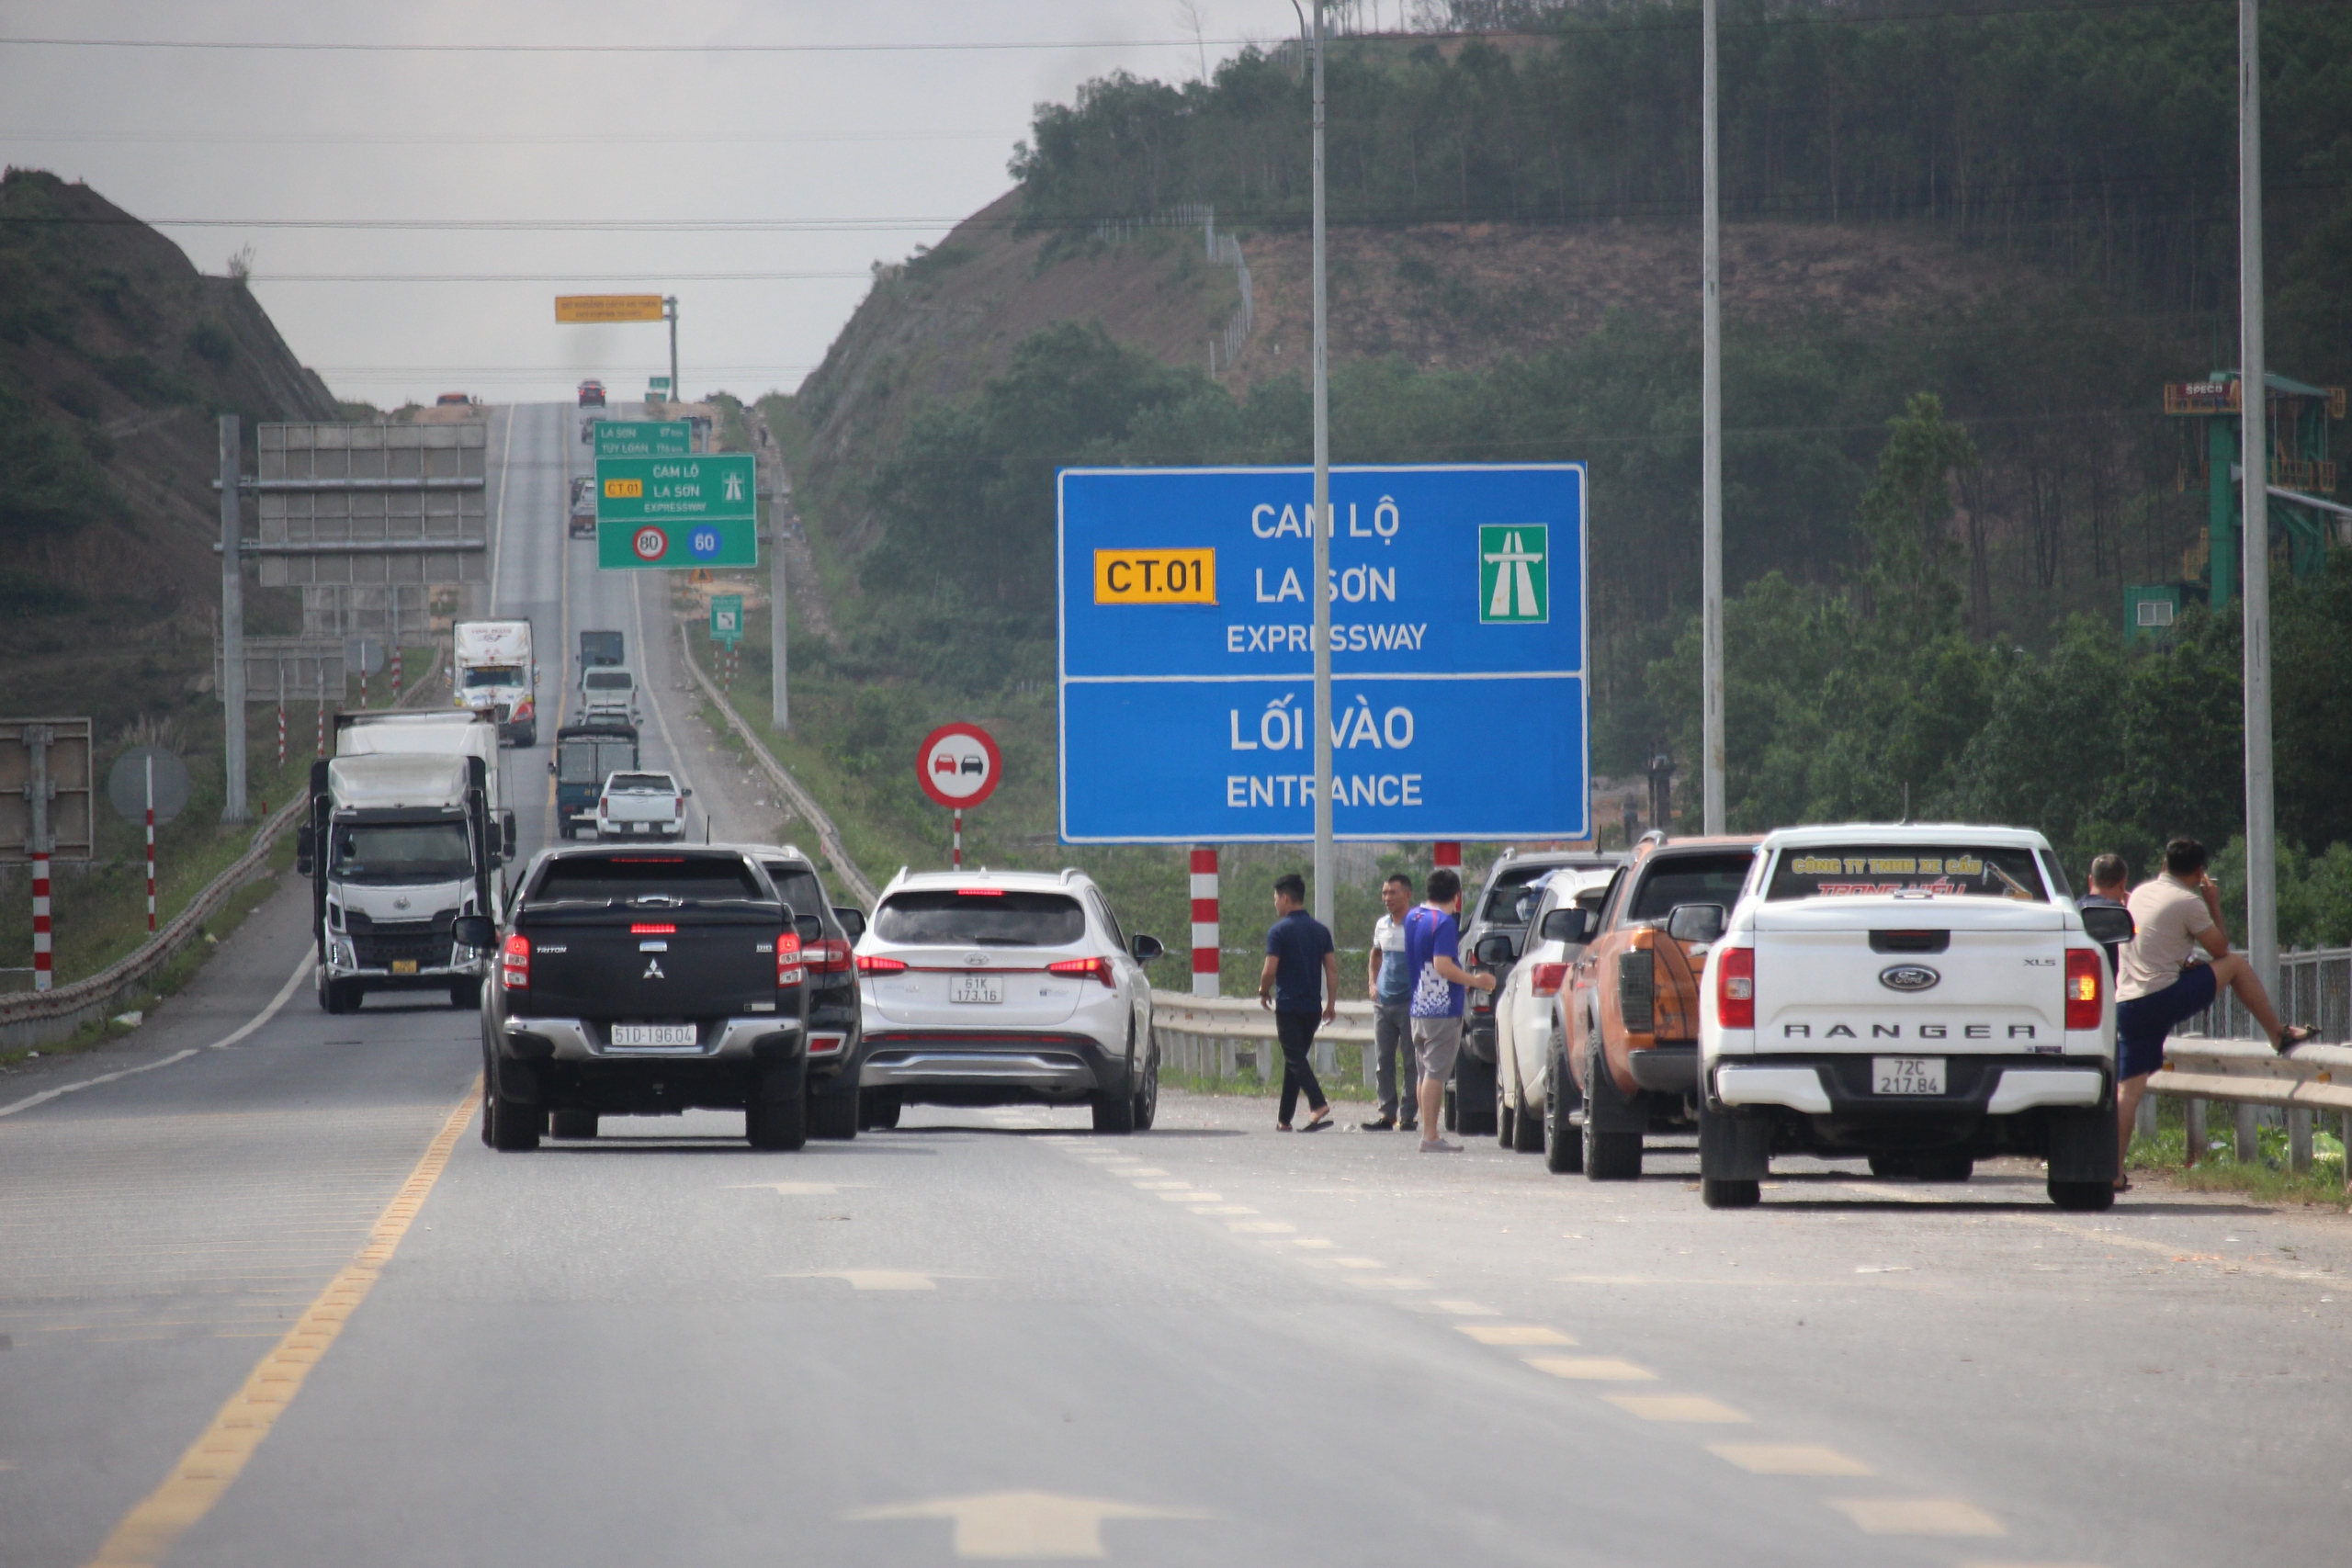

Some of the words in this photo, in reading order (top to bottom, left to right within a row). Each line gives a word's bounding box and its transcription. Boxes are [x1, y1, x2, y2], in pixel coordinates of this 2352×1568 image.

[601, 427, 614, 438] LA
[653, 465, 680, 478] CAM
[653, 485, 671, 497] LA
[644, 502, 707, 512] EXPRESSWAY
[1350, 494, 1399, 546] LỘ
[639, 536, 659, 550] 80
[695, 533, 714, 551] 60
[1107, 559, 1202, 592] CT.01
[1256, 567, 1305, 603] LA
[1230, 693, 1303, 750] LỐI
[1329, 693, 1414, 750] VÀO
[1227, 773, 1422, 807] ENTRANCE
[1792, 856, 1840, 874] CÔNG
[1844, 858, 1866, 874] TY
[1868, 858, 1917, 874] TNHH
[1918, 858, 1943, 874] XE
[537, 945, 567, 953] TRITON
[2024, 959, 2056, 967] XLS
[965, 978, 989, 989] 61K
[957, 990, 998, 1002] 173.16
[615, 1027, 692, 1043] 51D-196.04
[1784, 1023, 2035, 1040] RANGER
[1894, 1060, 1926, 1077] 72C
[1881, 1077, 1938, 1094] 217.84
